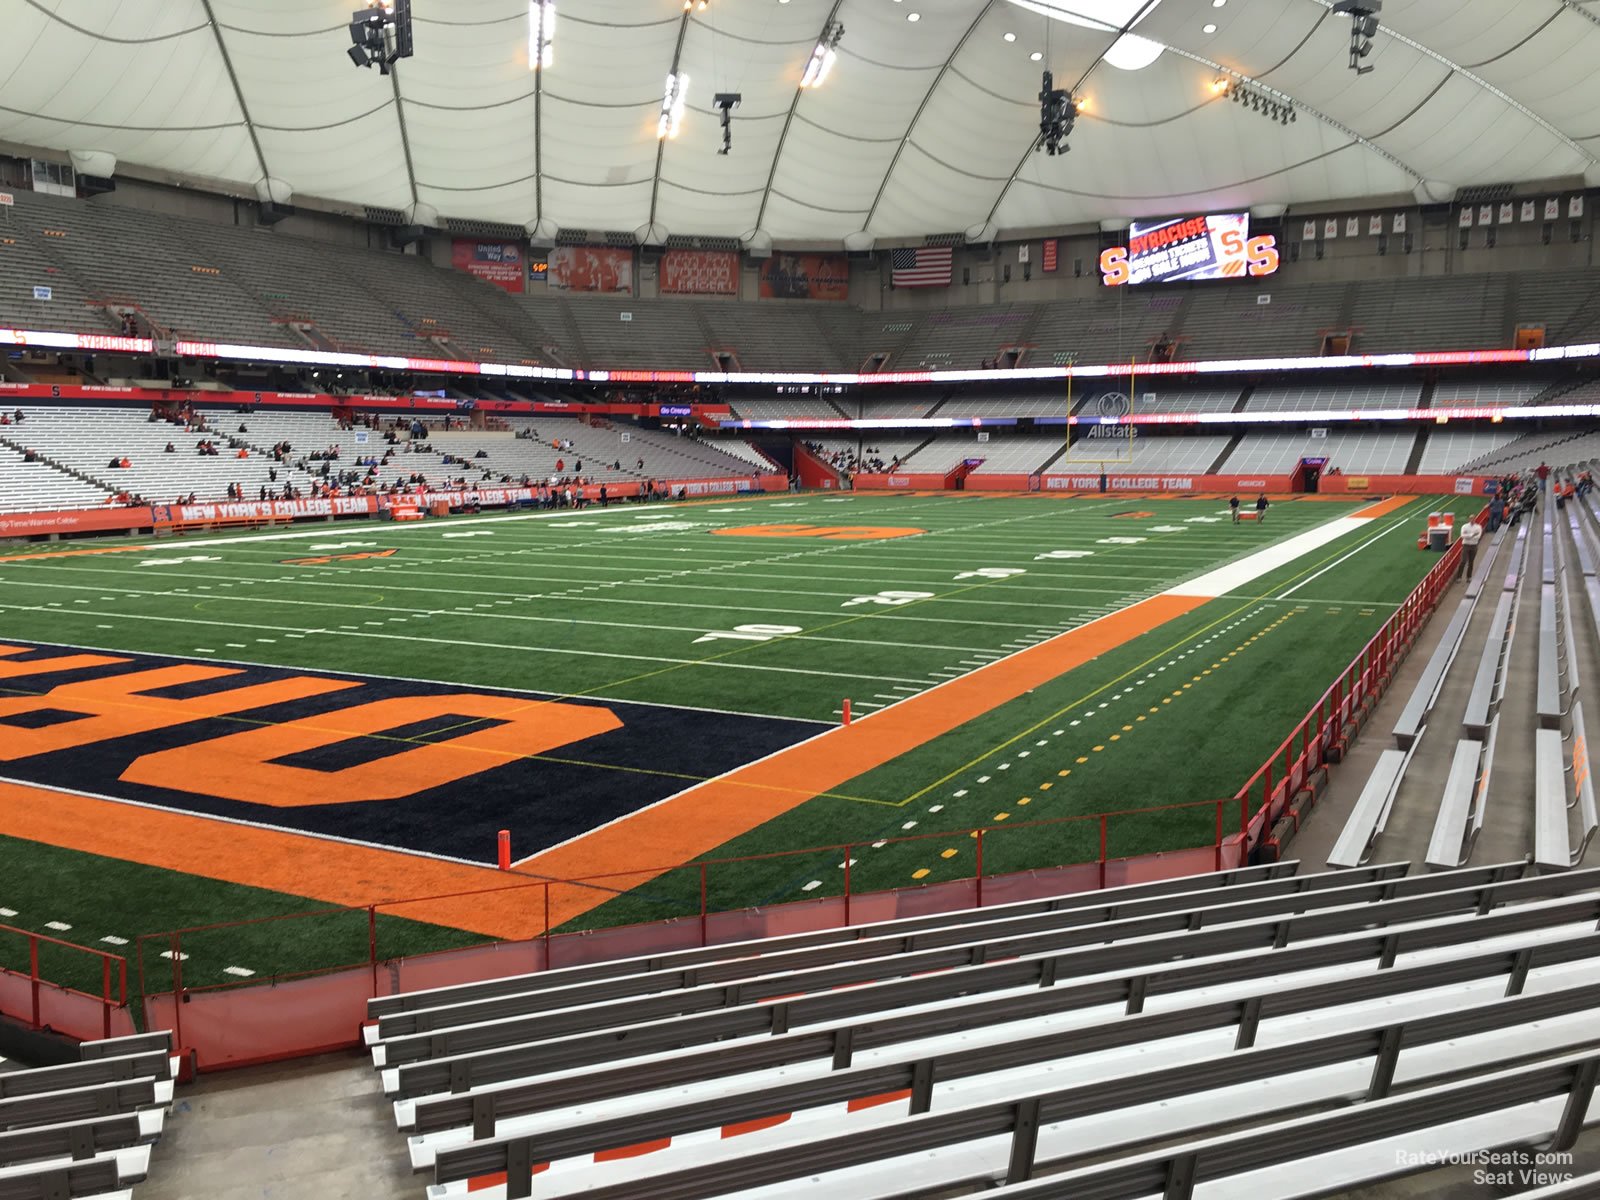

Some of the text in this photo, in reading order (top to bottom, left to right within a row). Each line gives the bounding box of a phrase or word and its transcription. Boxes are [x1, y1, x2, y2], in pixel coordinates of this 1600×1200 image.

[1130, 216, 1207, 254] SYRACUSE
[1221, 230, 1243, 255] S
[478, 244, 501, 253] United
[487, 252, 501, 261] Way
[1247, 235, 1280, 276] S
[1100, 247, 1130, 286] S
[78, 335, 138, 351] SYRACUSE
[610, 371, 653, 381] SYRACUSE
[661, 406, 690, 415] Go Orange
[1087, 424, 1138, 439] Allstate
[1047, 477, 1192, 489] NEW YORKS COLLEGE TEAM
[181, 497, 369, 522] NEW YORK'S COLLEGE TEAM
[9, 517, 79, 528] Time Warner Cable
[840, 590, 935, 608] 20
[691, 624, 803, 644] 10
